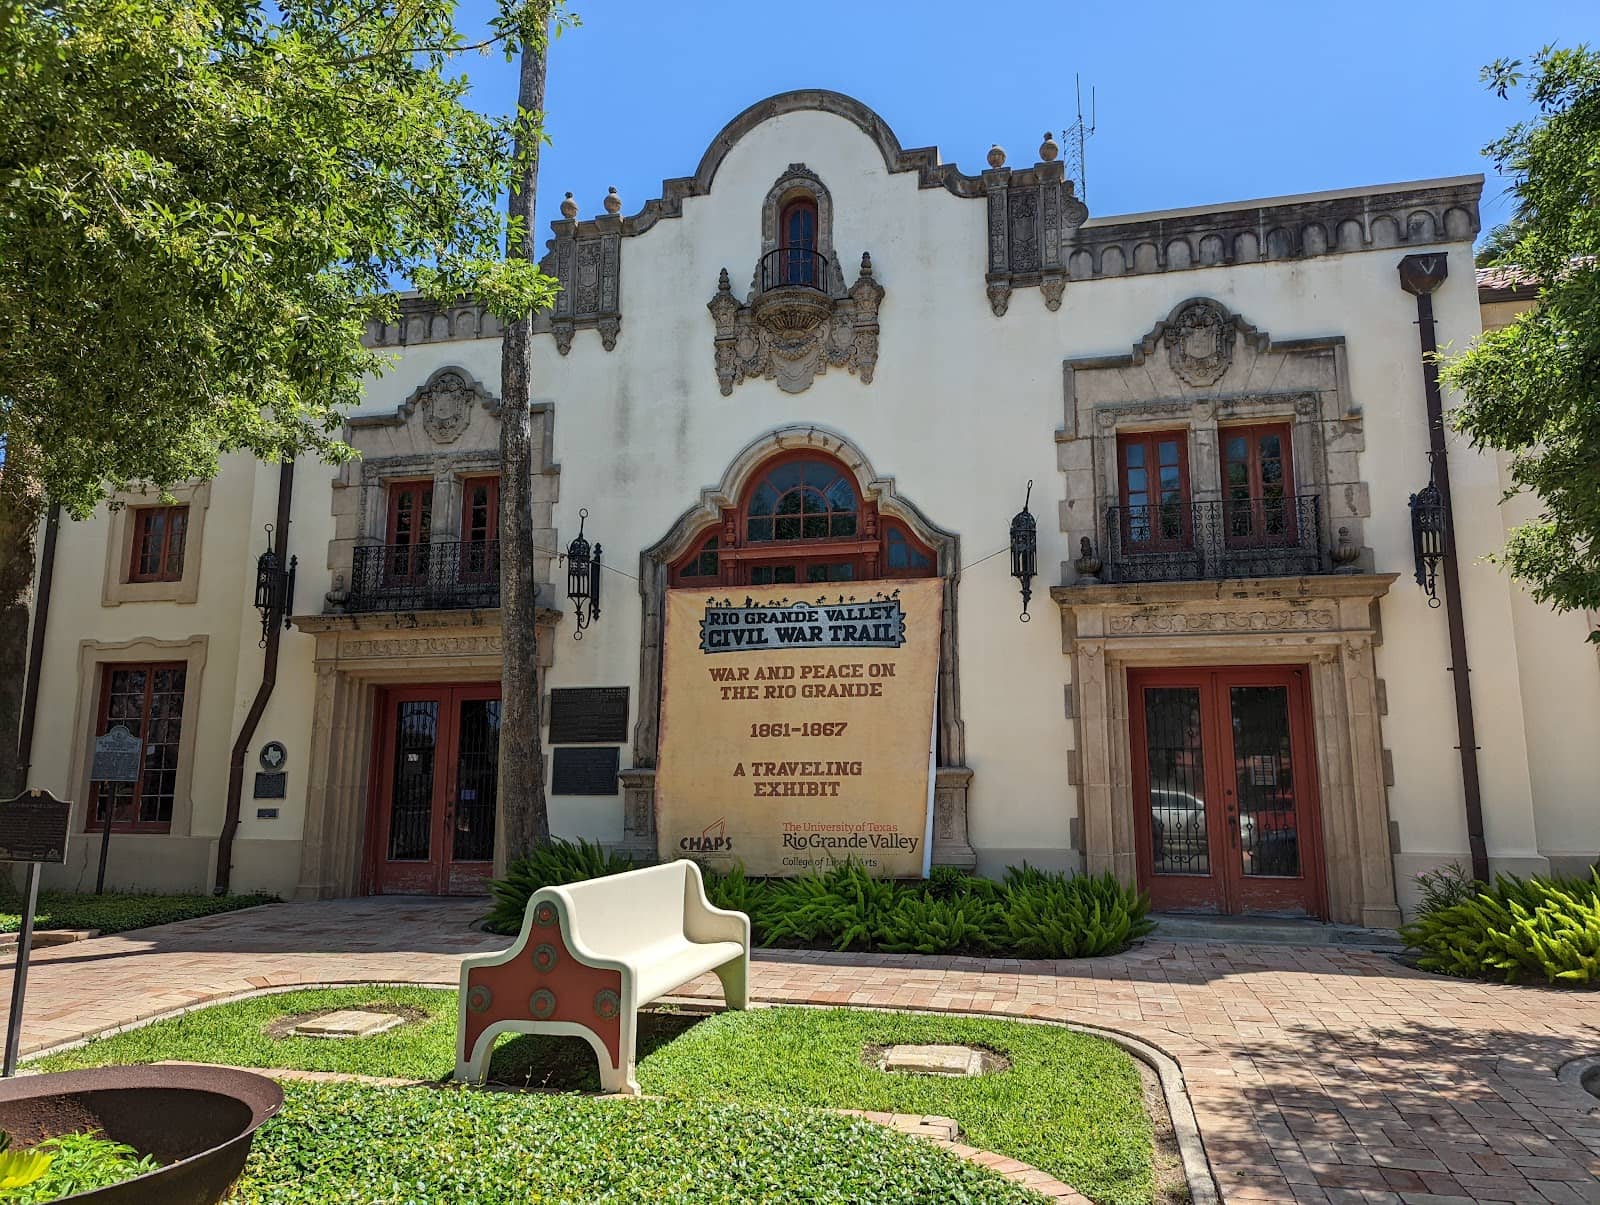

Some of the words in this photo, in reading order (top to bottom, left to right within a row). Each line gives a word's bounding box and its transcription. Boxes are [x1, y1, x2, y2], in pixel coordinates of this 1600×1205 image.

[709, 612, 740, 626] RIO
[744, 611, 818, 625] GRANDE
[825, 606, 897, 622] VALLEY
[708, 628, 768, 648] CIVIL
[775, 627, 823, 643] WAR
[829, 624, 897, 642] TRAIL
[709, 667, 749, 682] WAR
[754, 666, 795, 681] AND
[800, 664, 864, 680] PEACE
[868, 663, 896, 678] ON
[720, 686, 759, 700] THE
[763, 685, 797, 699] RIO
[801, 683, 883, 698] GRANDE
[750, 722, 848, 738] 1861-1867
[733, 763, 746, 777] A
[752, 761, 863, 777] TRAVELING
[753, 781, 841, 797] EXHIBIT
[782, 822, 801, 832] The
[803, 822, 856, 834] University
[856, 822, 867, 832] of
[868, 822, 898, 832] Texas
[680, 836, 732, 851] CHAPS
[782, 832, 808, 851] Rio
[808, 833, 868, 849] Grande
[869, 833, 919, 854] Valley
[815, 856, 825, 872] of
